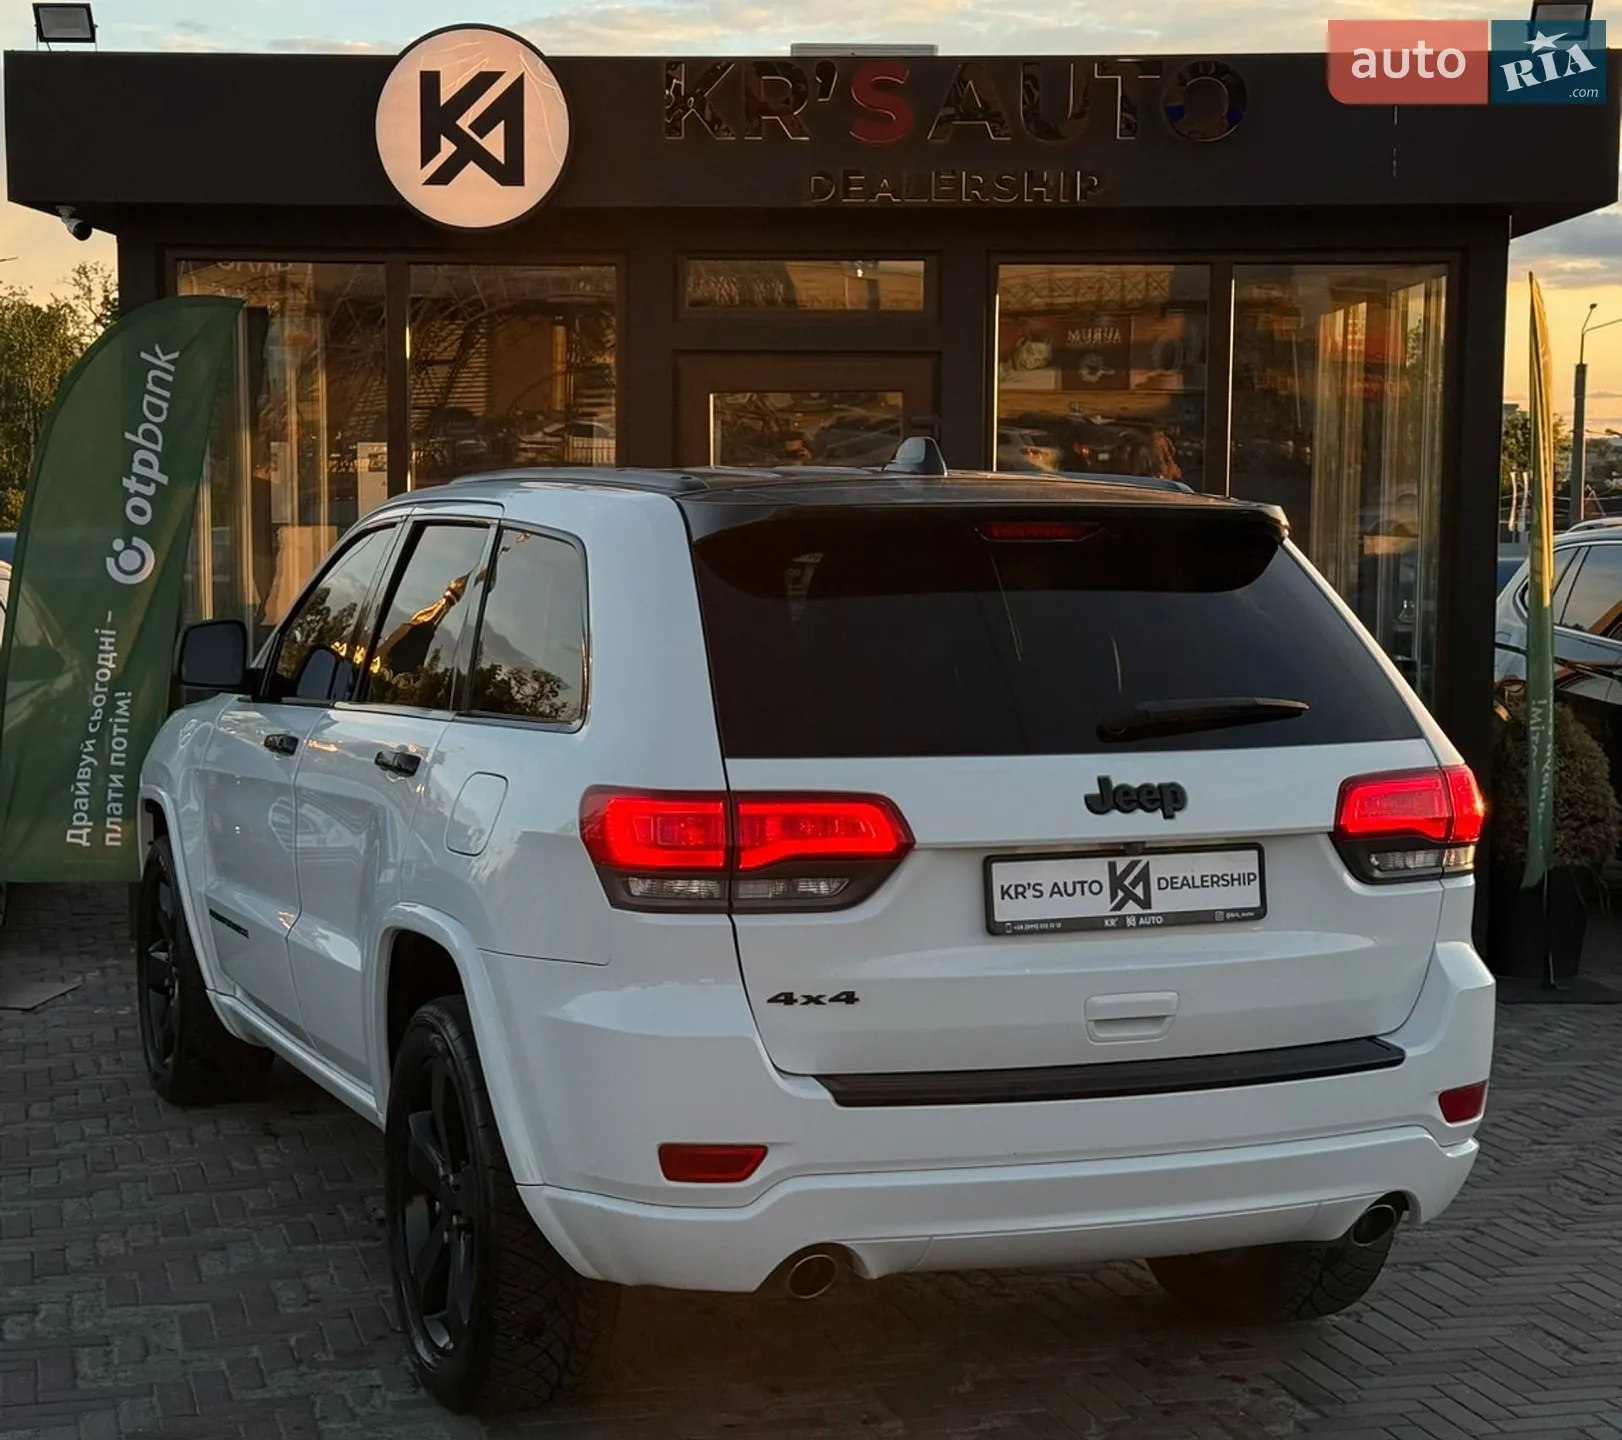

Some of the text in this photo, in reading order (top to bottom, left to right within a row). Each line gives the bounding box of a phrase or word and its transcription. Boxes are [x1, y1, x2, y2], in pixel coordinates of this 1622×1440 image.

[664, 59, 1248, 144] KR'S AUTO
[808, 170, 1102, 203] DEALERSHIP
[122, 343, 180, 526] otpbank
[66, 739, 98, 847] Драйвуй
[88, 628, 118, 733] сьогодні
[105, 691, 133, 847] плати потім!
[1084, 775, 1188, 819] Jeep
[1000, 882, 1044, 900] KR'S
[1049, 879, 1103, 899] AUTO
[1157, 871, 1257, 891] DEALERSHIP
[1138, 915, 1164, 925] AUTO
[766, 990, 860, 1006] 4x4
